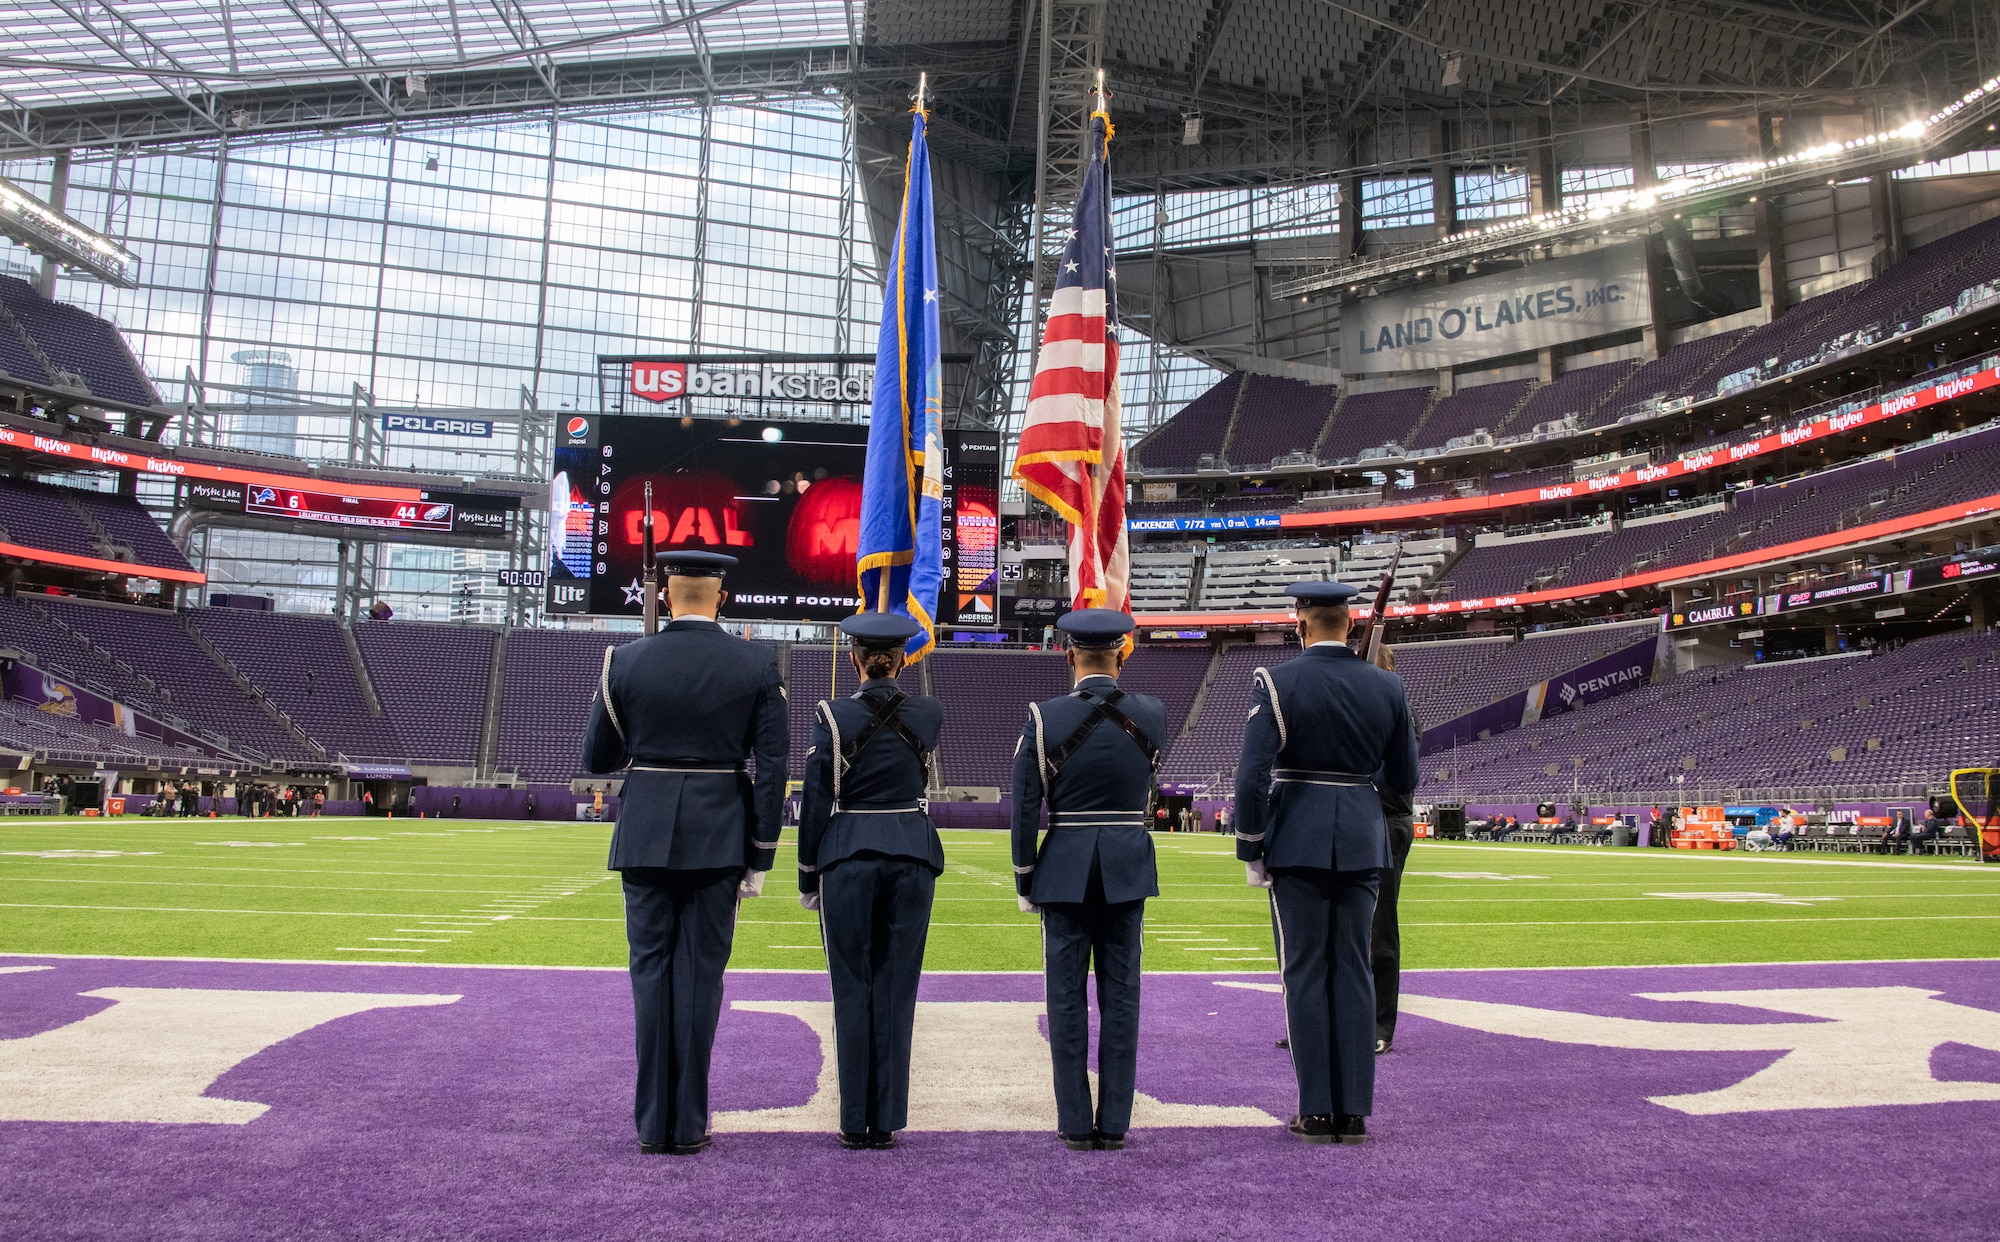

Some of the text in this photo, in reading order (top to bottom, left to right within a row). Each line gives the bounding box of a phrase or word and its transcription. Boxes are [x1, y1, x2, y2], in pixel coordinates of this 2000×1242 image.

[1359, 284, 1626, 355] LAND O'LAKES, INC.
[387, 415, 487, 435] POLARIS
[289, 495, 299, 509] 6
[596, 445, 613, 575] COWBOYS
[397, 506, 416, 520] 44
[942, 466, 953, 578] VIKINGS
[624, 507, 754, 547] DAL
[1131, 521, 1175, 530] MCKENZIE
[1184, 520, 1205, 529] 7/72
[1255, 518, 1265, 526] 14
[501, 572, 542, 586] 90:00
[1003, 565, 1020, 578] 25
[1942, 563, 1960, 578] 3M
[552, 584, 587, 605] Lite
[1814, 581, 1879, 599] AUTOMOTIVE PRODUCTS
[735, 594, 863, 607] NIGHT FOOTBA
[1688, 605, 1735, 623] CAMBRIA
[1578, 665, 1643, 695] PENTAIR
